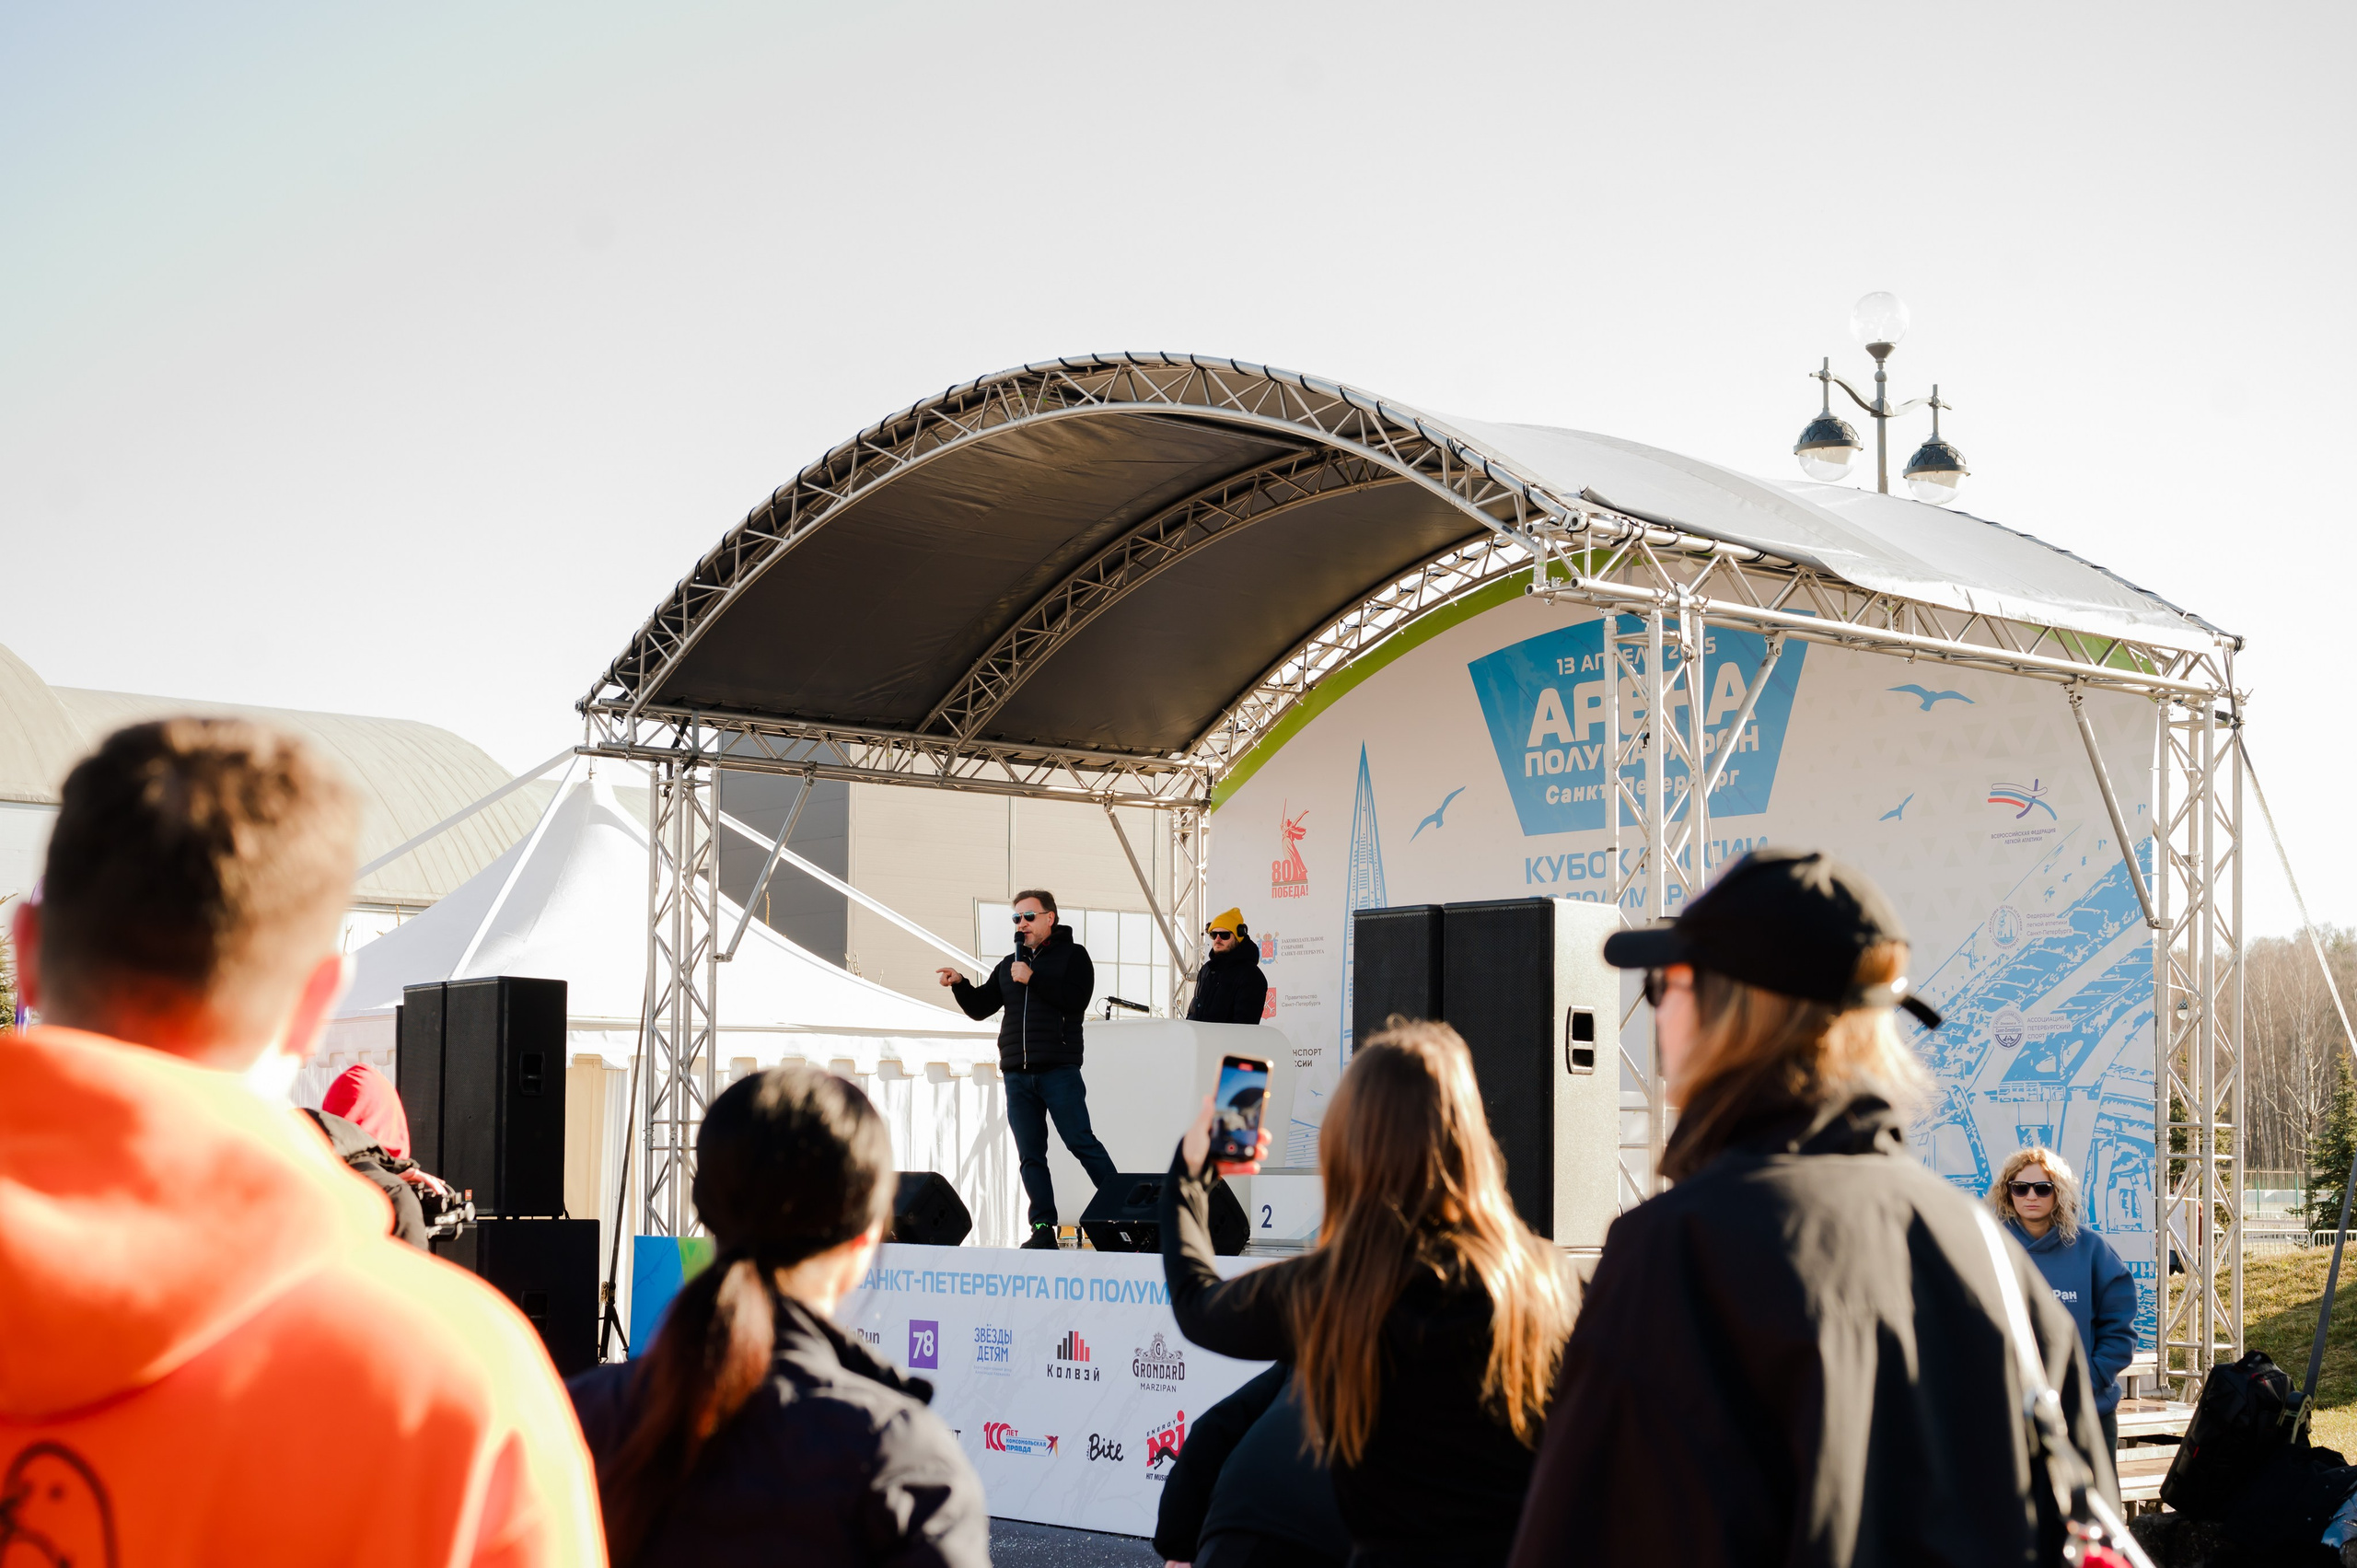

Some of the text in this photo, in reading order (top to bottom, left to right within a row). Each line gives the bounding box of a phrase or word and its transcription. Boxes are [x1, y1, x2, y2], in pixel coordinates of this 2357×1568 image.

[1556, 636, 1716, 675] 13 АПЕЛ 25
[1527, 662, 1757, 748] АРЕНА
[1525, 725, 1759, 777] ПОЛУМААФОН
[1545, 768, 1740, 805] СанктПееррг
[1991, 830, 2029, 839] ВСЕРОССИЙСКАЯ
[1271, 860, 1292, 882] 80
[1525, 848, 1631, 885] КУБОК
[1271, 885, 1309, 899] ПОБЕДА!
[2026, 928, 2073, 936] Санкт-Петербурга
[2026, 1023, 2071, 1031] ПЕТЕРБУРГСКИЙ
[1260, 1204, 1272, 1228] 2
[858, 1268, 1172, 1306] АНКТ-ПЕТЕРБУРГА ПО ПОЛУМ
[2052, 1289, 2078, 1300] Ран
[912, 1330, 935, 1360] 78
[974, 1324, 1013, 1345] ЗВЁЗДЫ
[976, 1345, 1009, 1363] ДЕТЯМ
[1132, 1358, 1185, 1381] GRONDARD
[1140, 1383, 1177, 1393] MARZIPAN
[1146, 1419, 1177, 1436] ENERGY
[1005, 1437, 1047, 1447] КОМСОМОЛЬСКАЯ
[1005, 1445, 1031, 1453] ПРАВДА
[1088, 1433, 1124, 1461] Bite
